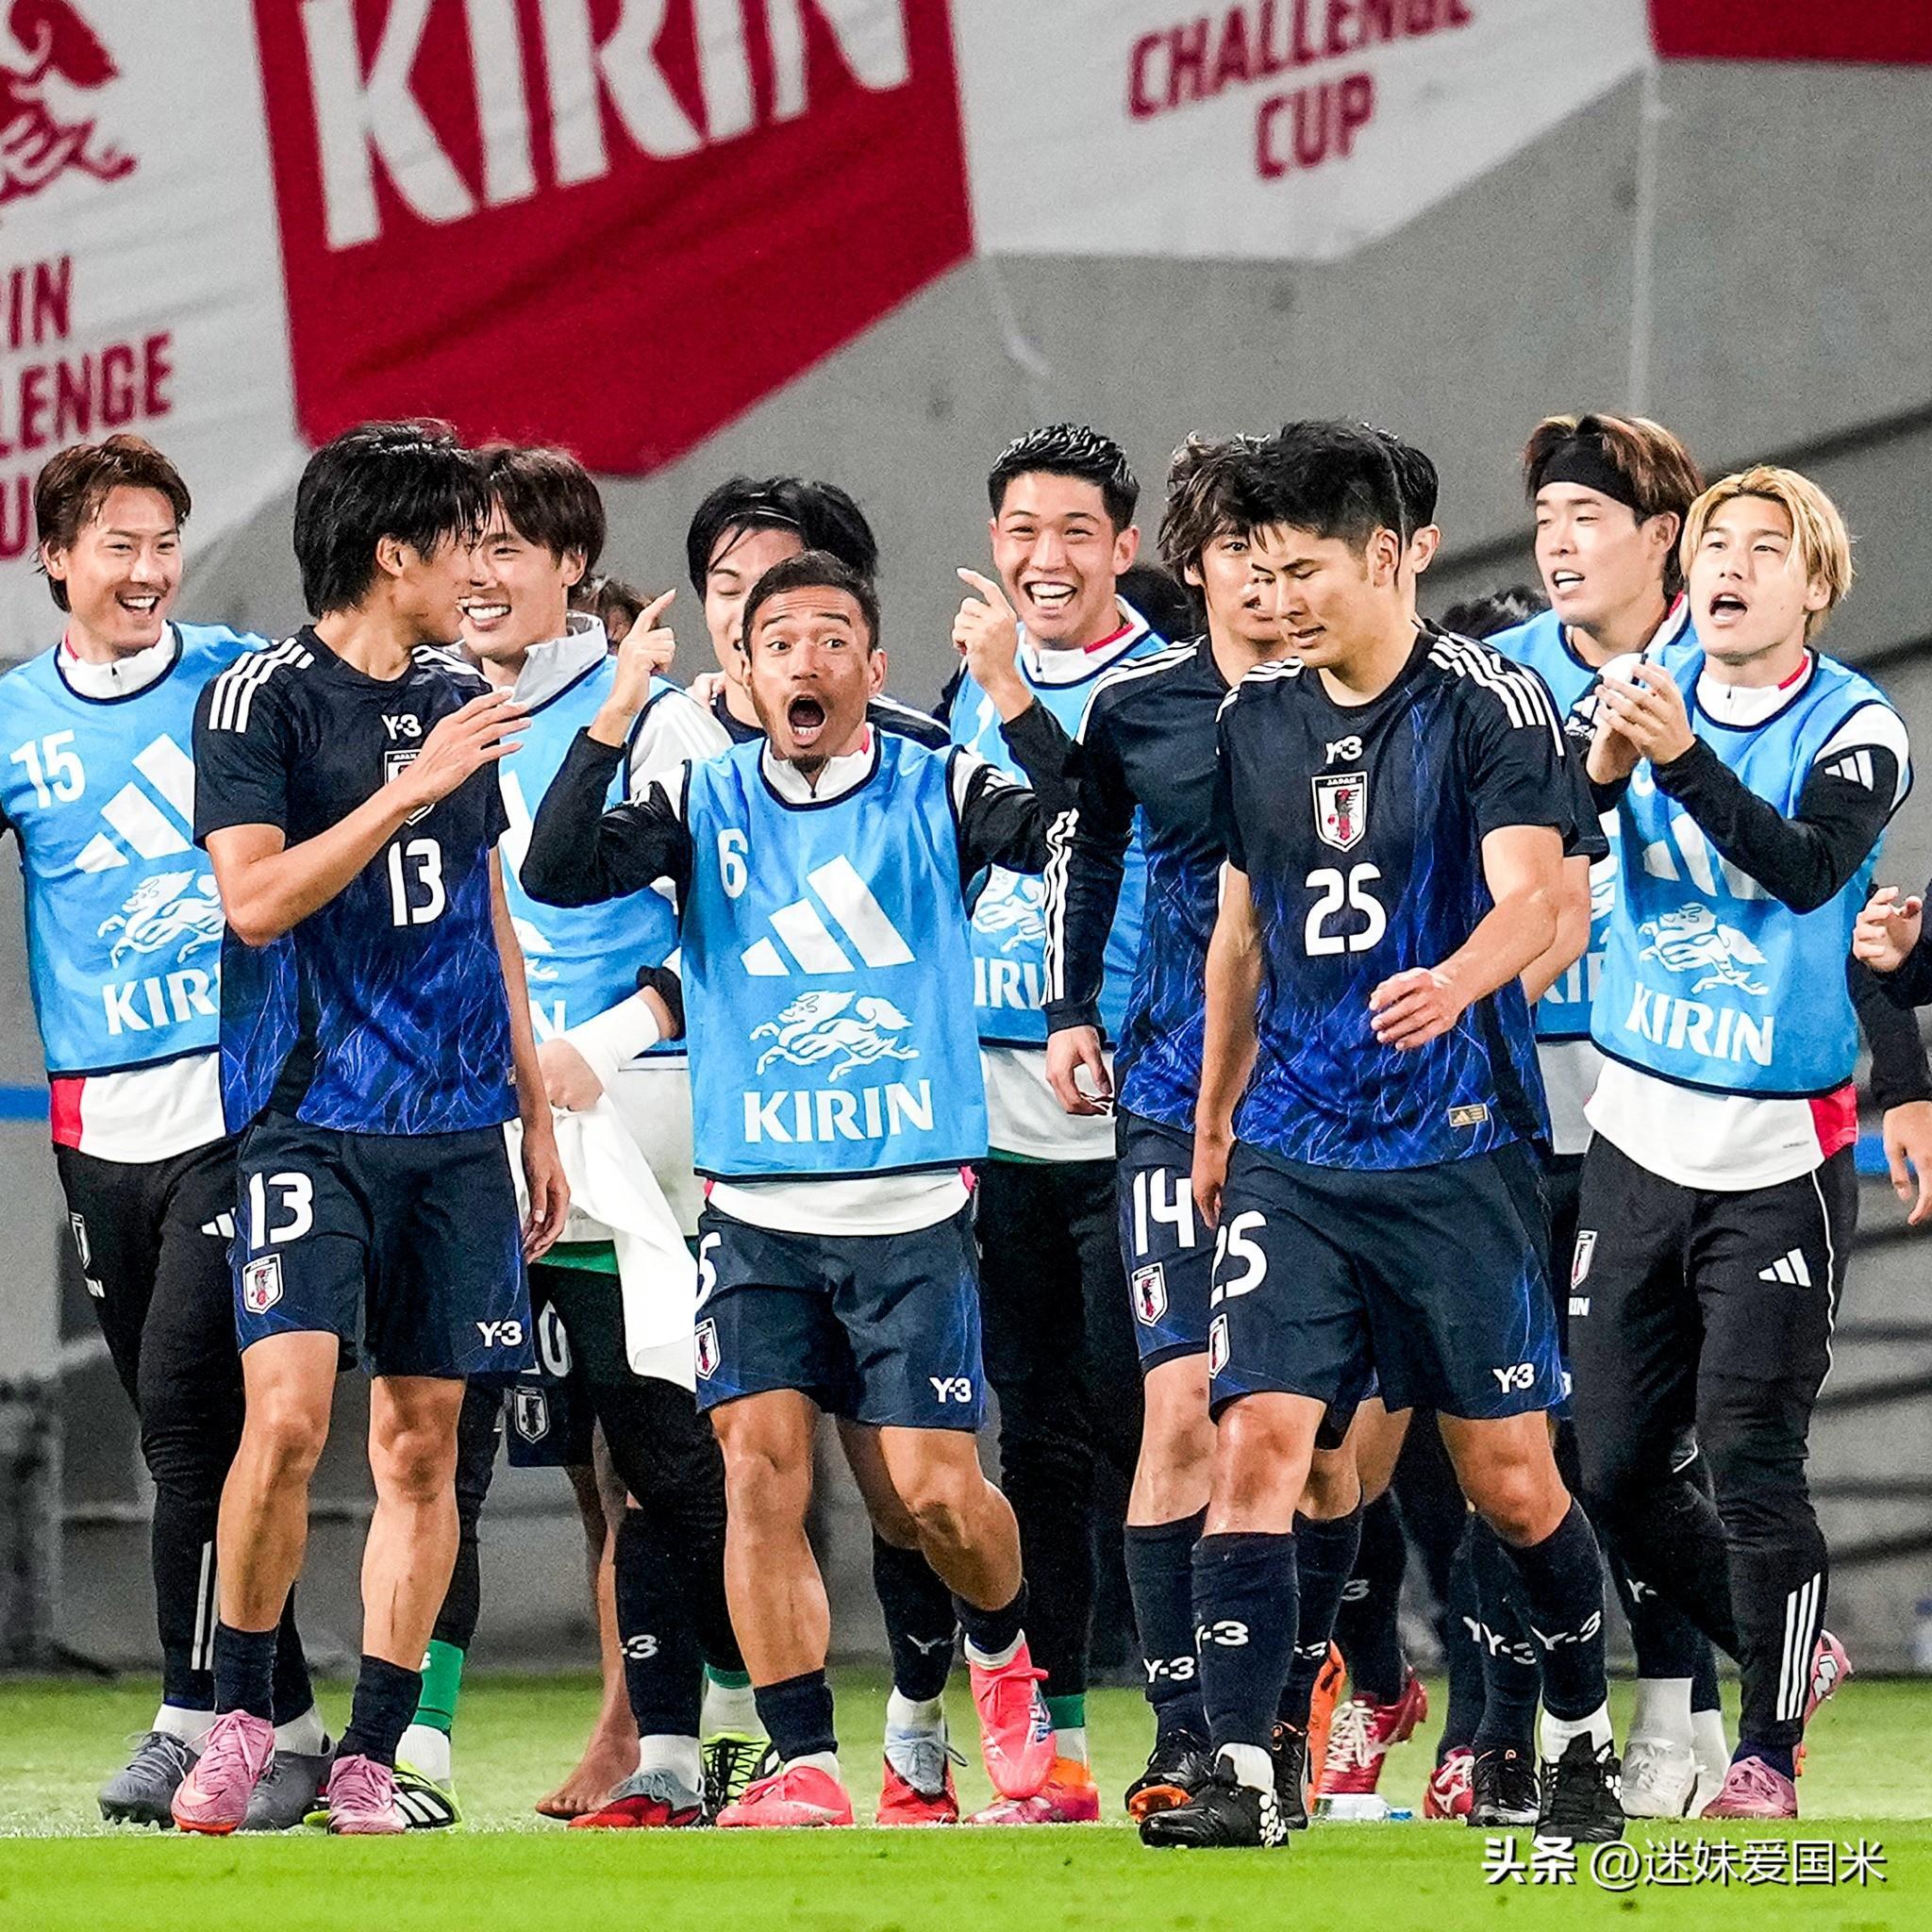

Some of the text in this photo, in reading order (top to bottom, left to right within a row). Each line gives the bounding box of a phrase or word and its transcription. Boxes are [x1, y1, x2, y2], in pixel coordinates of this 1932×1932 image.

[1254, 72, 1374, 178] CUP
[381, 714, 422, 740] Y-3
[1325, 736, 1363, 764] Y-3
[9, 728, 86, 809] 15
[388, 838, 445, 926] 13
[718, 828, 748, 898] 6
[1305, 862, 1387, 956] 25
[102, 968, 218, 1036] KIR
[1624, 980, 1774, 1066] KIRIN
[743, 1079, 934, 1143] KIRIN
[249, 1172, 313, 1250] 13
[1133, 1168, 1195, 1257] 14
[475, 1321, 523, 1347] Y-3
[929, 1376, 972, 1403] Y-3
[1492, 1363, 1535, 1393] Y-3
[1481, 1622, 1537, 1665] Y-3
[1529, 1609, 1602, 1651] Y-3
[1142, 1656, 1195, 1684] Y-3
